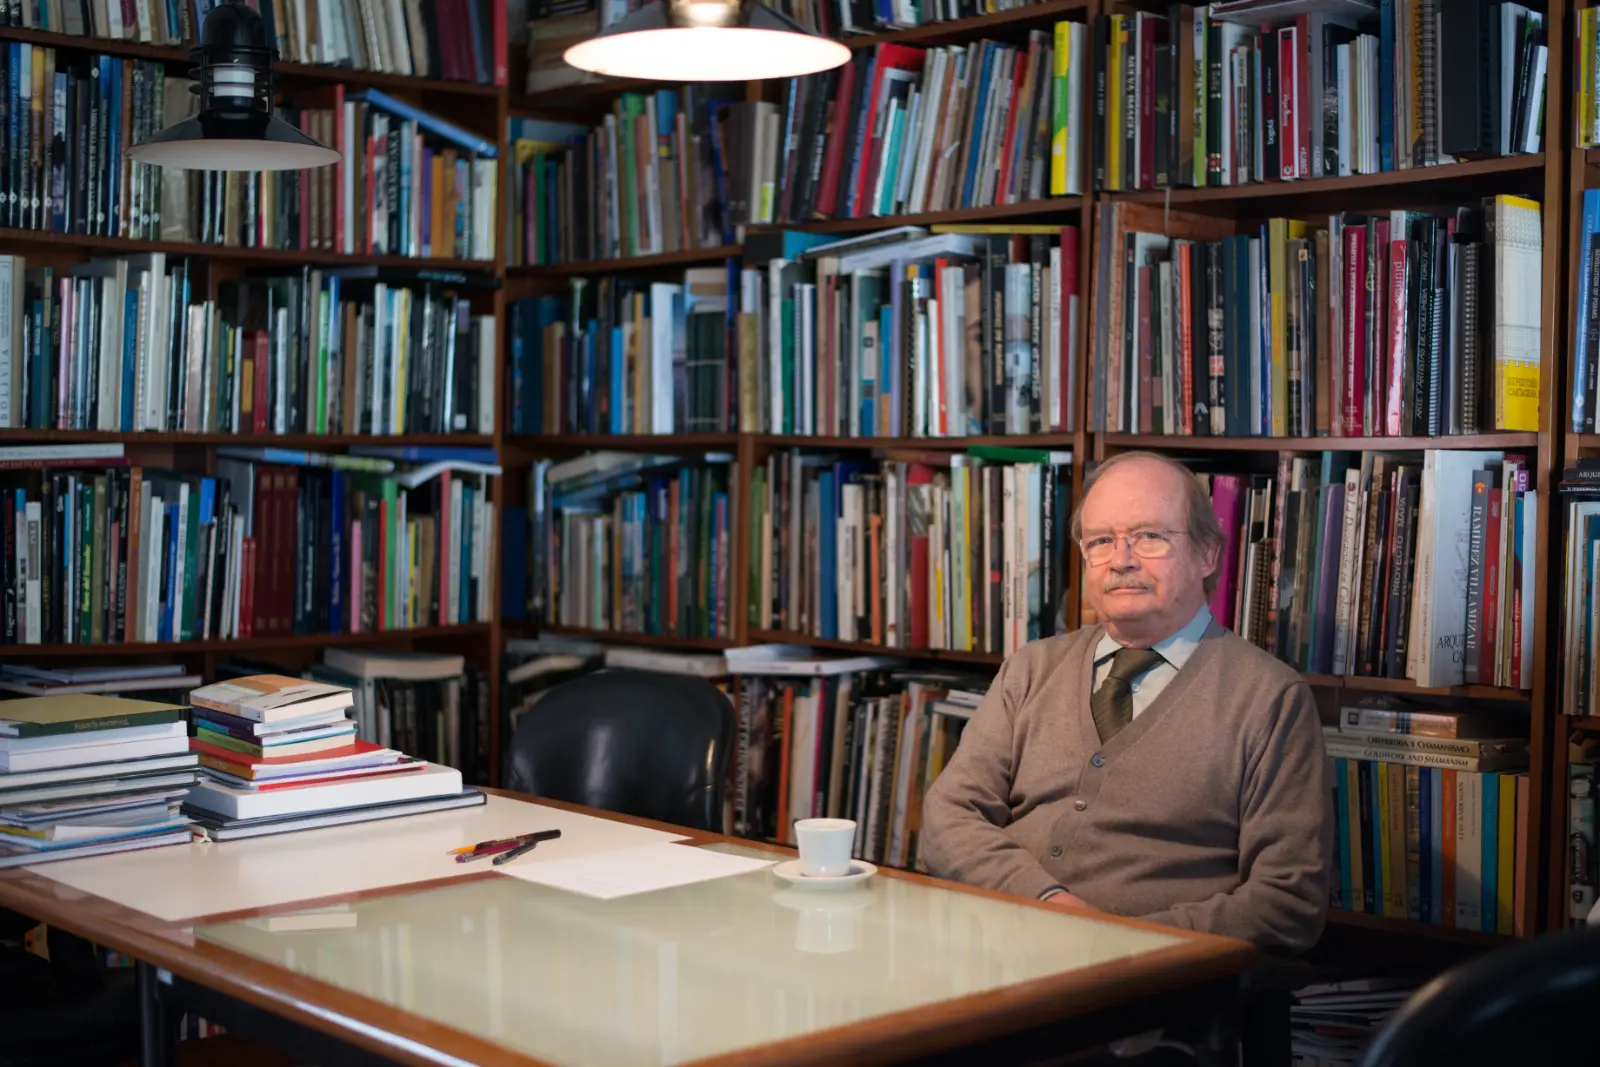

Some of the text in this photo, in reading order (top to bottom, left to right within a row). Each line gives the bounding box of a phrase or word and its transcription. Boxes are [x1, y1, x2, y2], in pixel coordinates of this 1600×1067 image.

[1420, 287, 1428, 333] COLOMBIA
[1419, 334, 1427, 347] DE
[0, 347, 9, 421] BOLIVIA
[1417, 347, 1426, 388] ARTISTAS
[1415, 397, 1424, 420] ARTE
[1397, 496, 1407, 528] MAPA
[1392, 535, 1404, 597] PROYECTO
[1467, 506, 1484, 650] RAMÍREZ VILLAMIZAR
[1364, 749, 1470, 768] GOLDWORK AND SHAMANISM
[1417, 741, 1471, 754] CHAMANISMO
